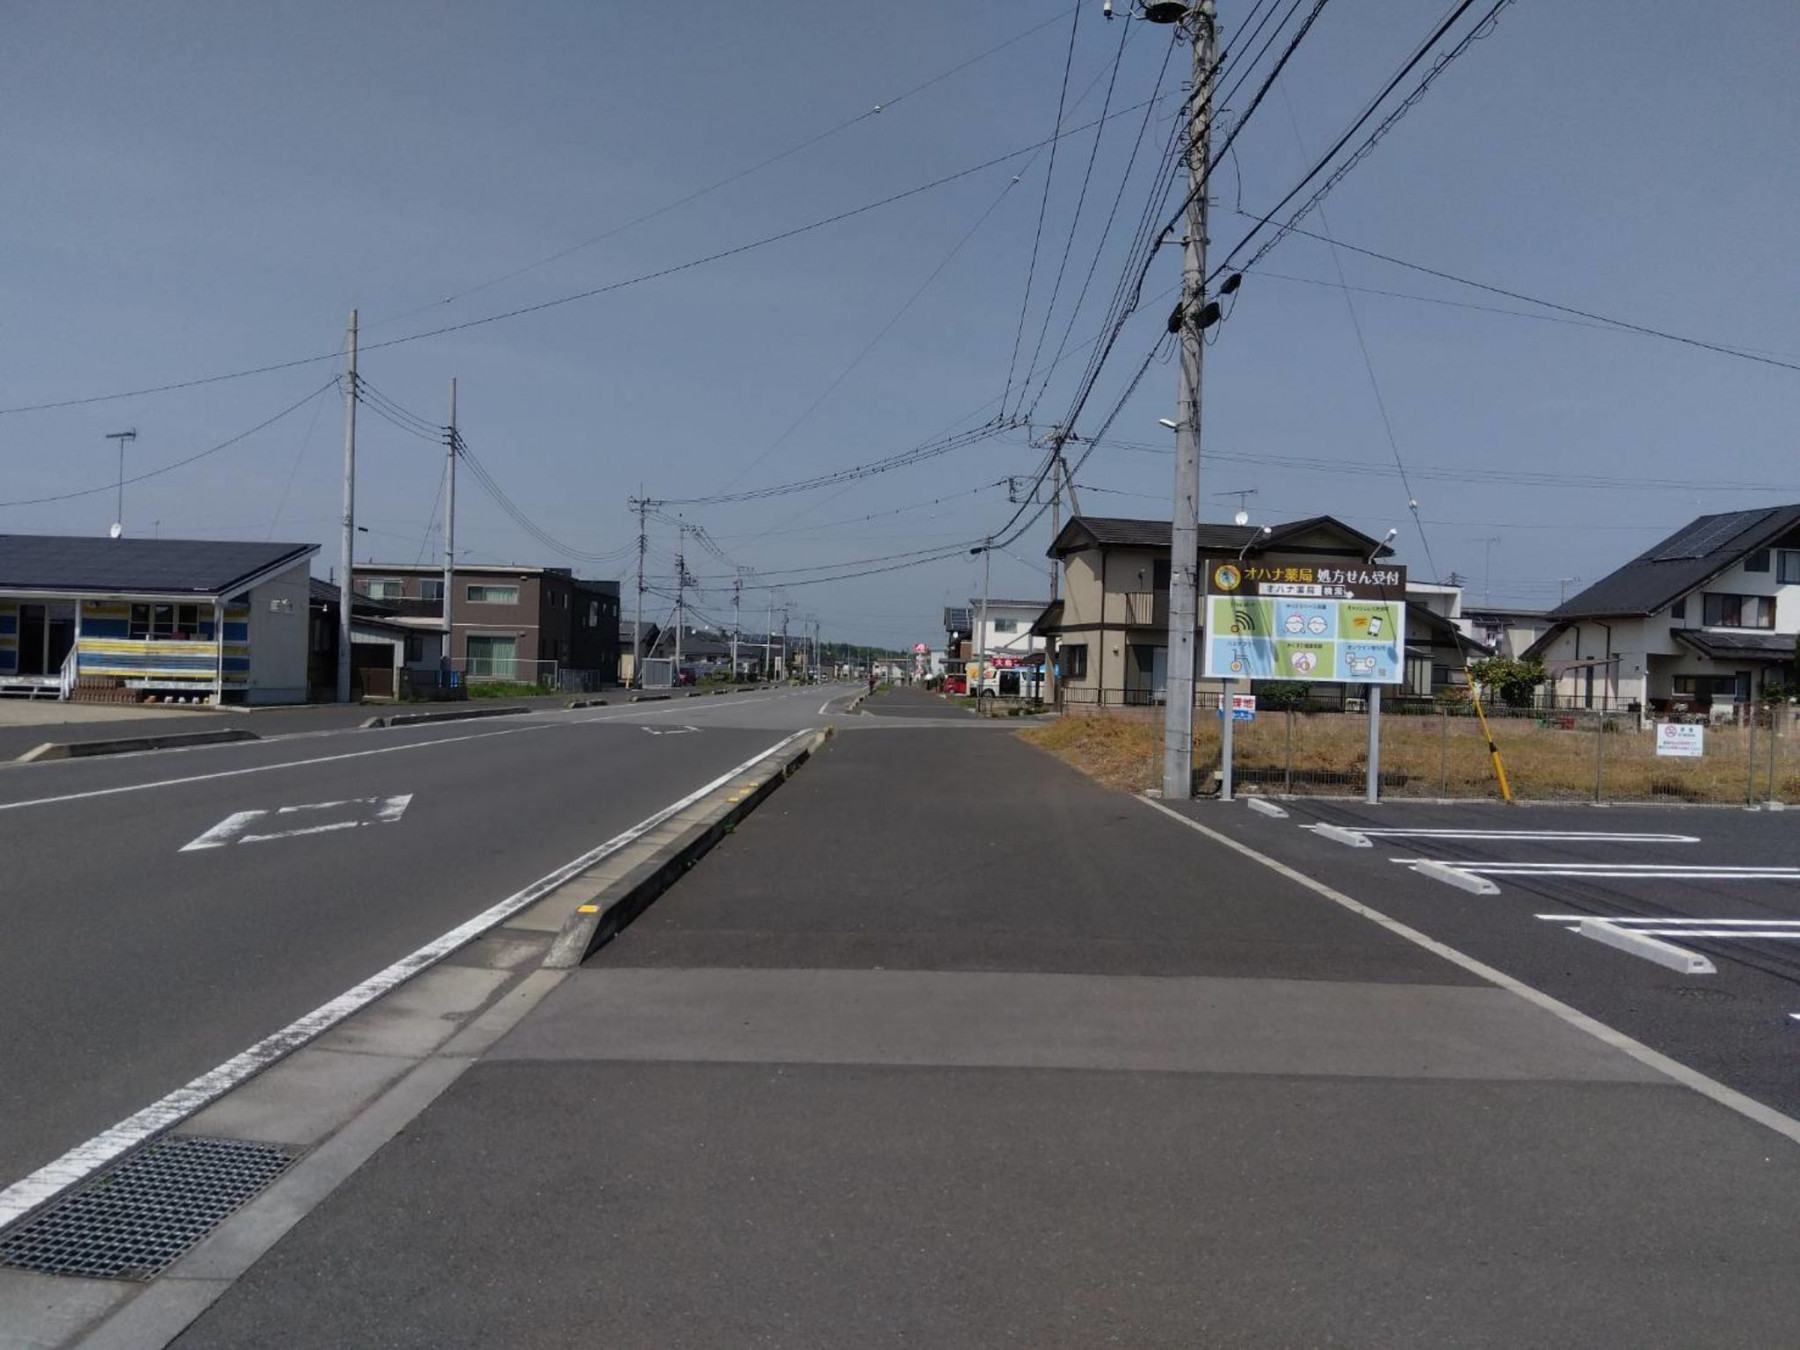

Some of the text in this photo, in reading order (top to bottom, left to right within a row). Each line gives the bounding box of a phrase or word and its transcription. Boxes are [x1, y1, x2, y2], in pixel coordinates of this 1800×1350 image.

[1244, 567, 1400, 586] オハナ薬局 処方せん受付
[1266, 584, 1316, 595] オハナ薬局
